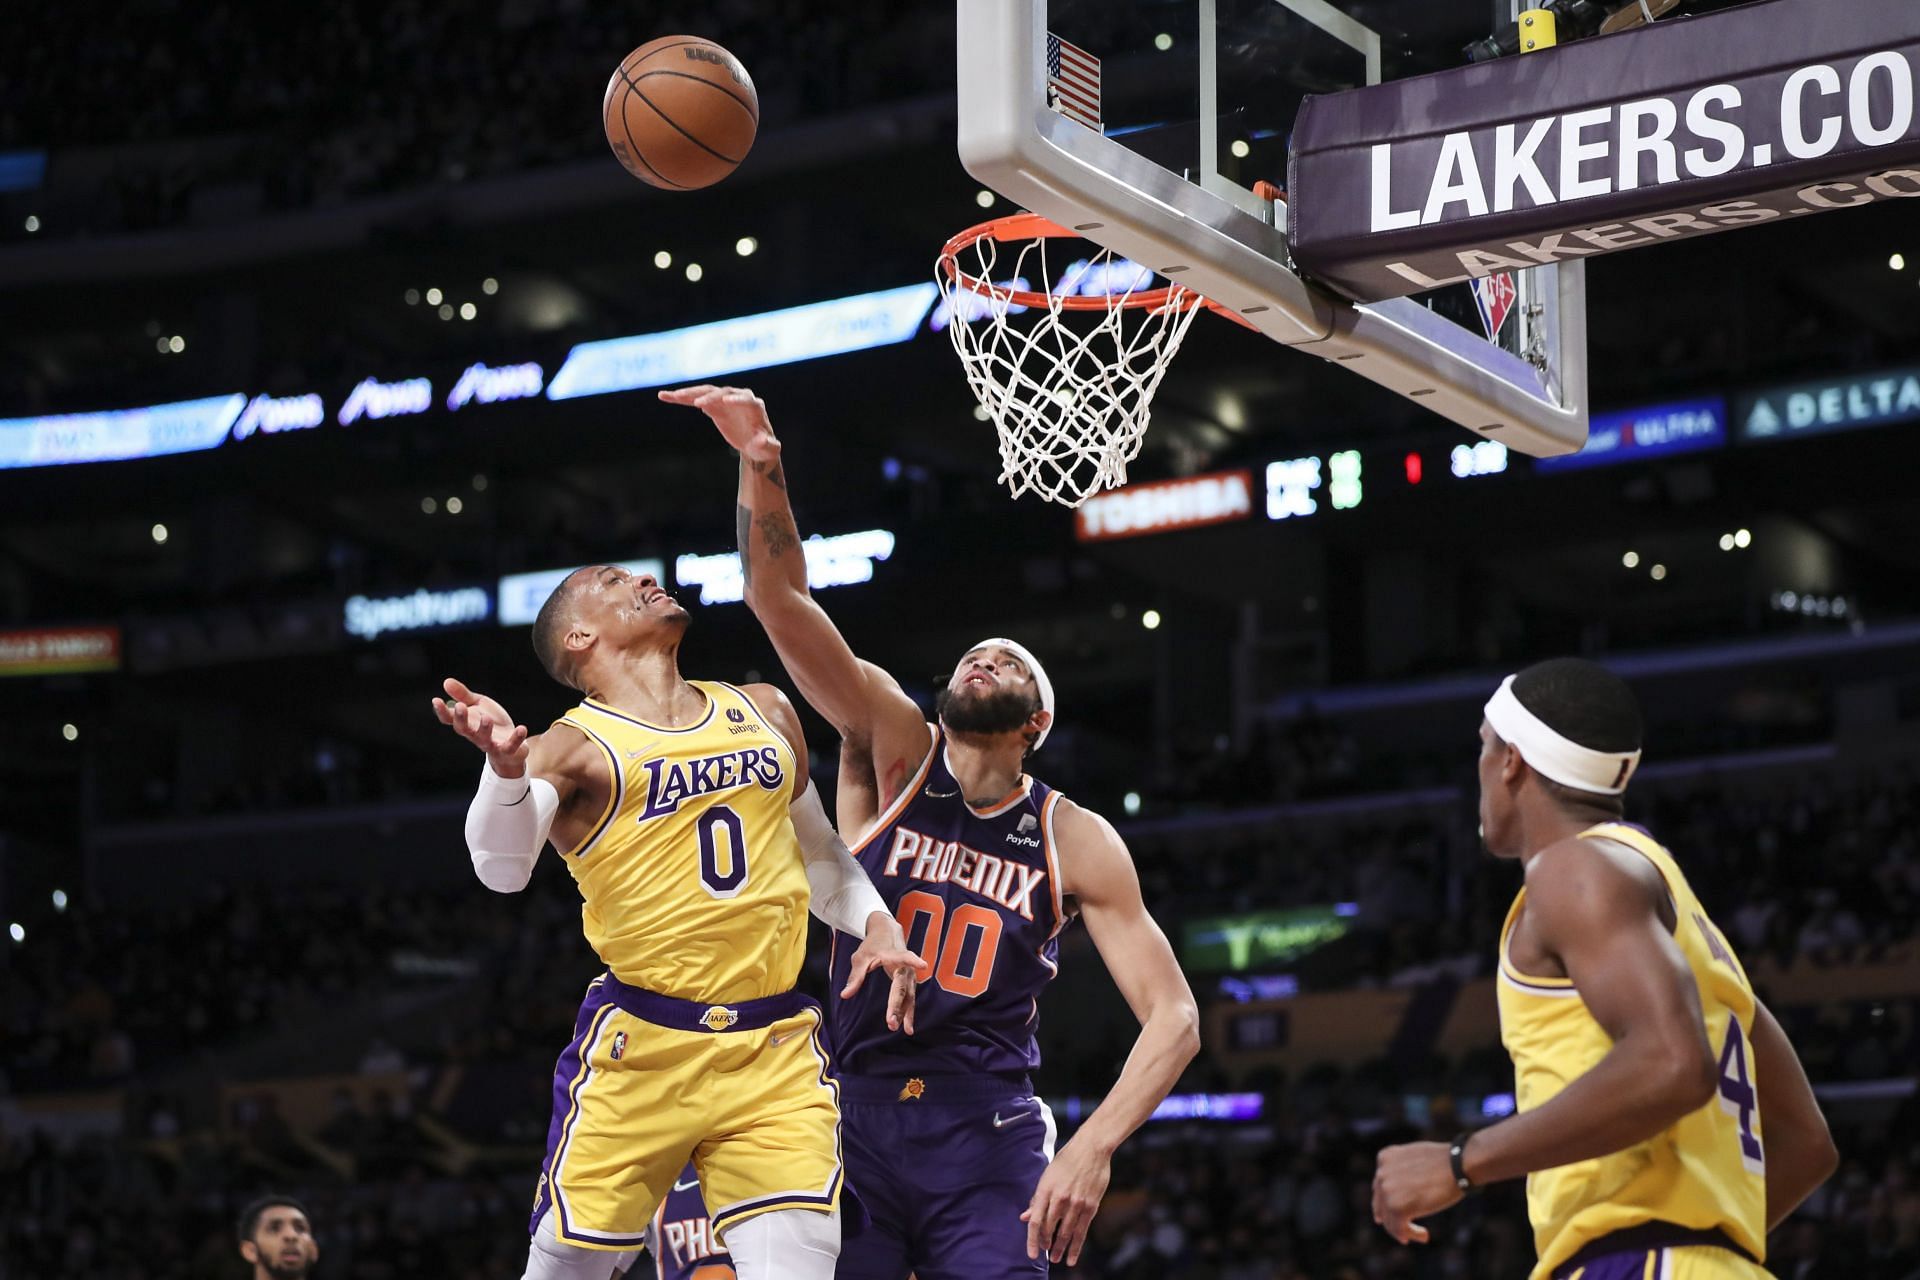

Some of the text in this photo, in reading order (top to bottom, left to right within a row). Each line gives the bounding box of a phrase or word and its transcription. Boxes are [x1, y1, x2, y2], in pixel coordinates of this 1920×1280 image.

[1370, 50, 1914, 233] LAKERS.CO
[1786, 375, 1920, 429] DELTA
[1078, 474, 1250, 537] TOSHIBA
[343, 584, 489, 640] Spectrum
[728, 722, 760, 736] bibigo
[637, 745, 784, 823] LAKERS
[696, 804, 749, 899] 0
[883, 825, 1047, 922] PHOENIX
[1005, 832, 1040, 849] PayPal
[896, 890, 1004, 999] 00
[1717, 1010, 1765, 1174] 4
